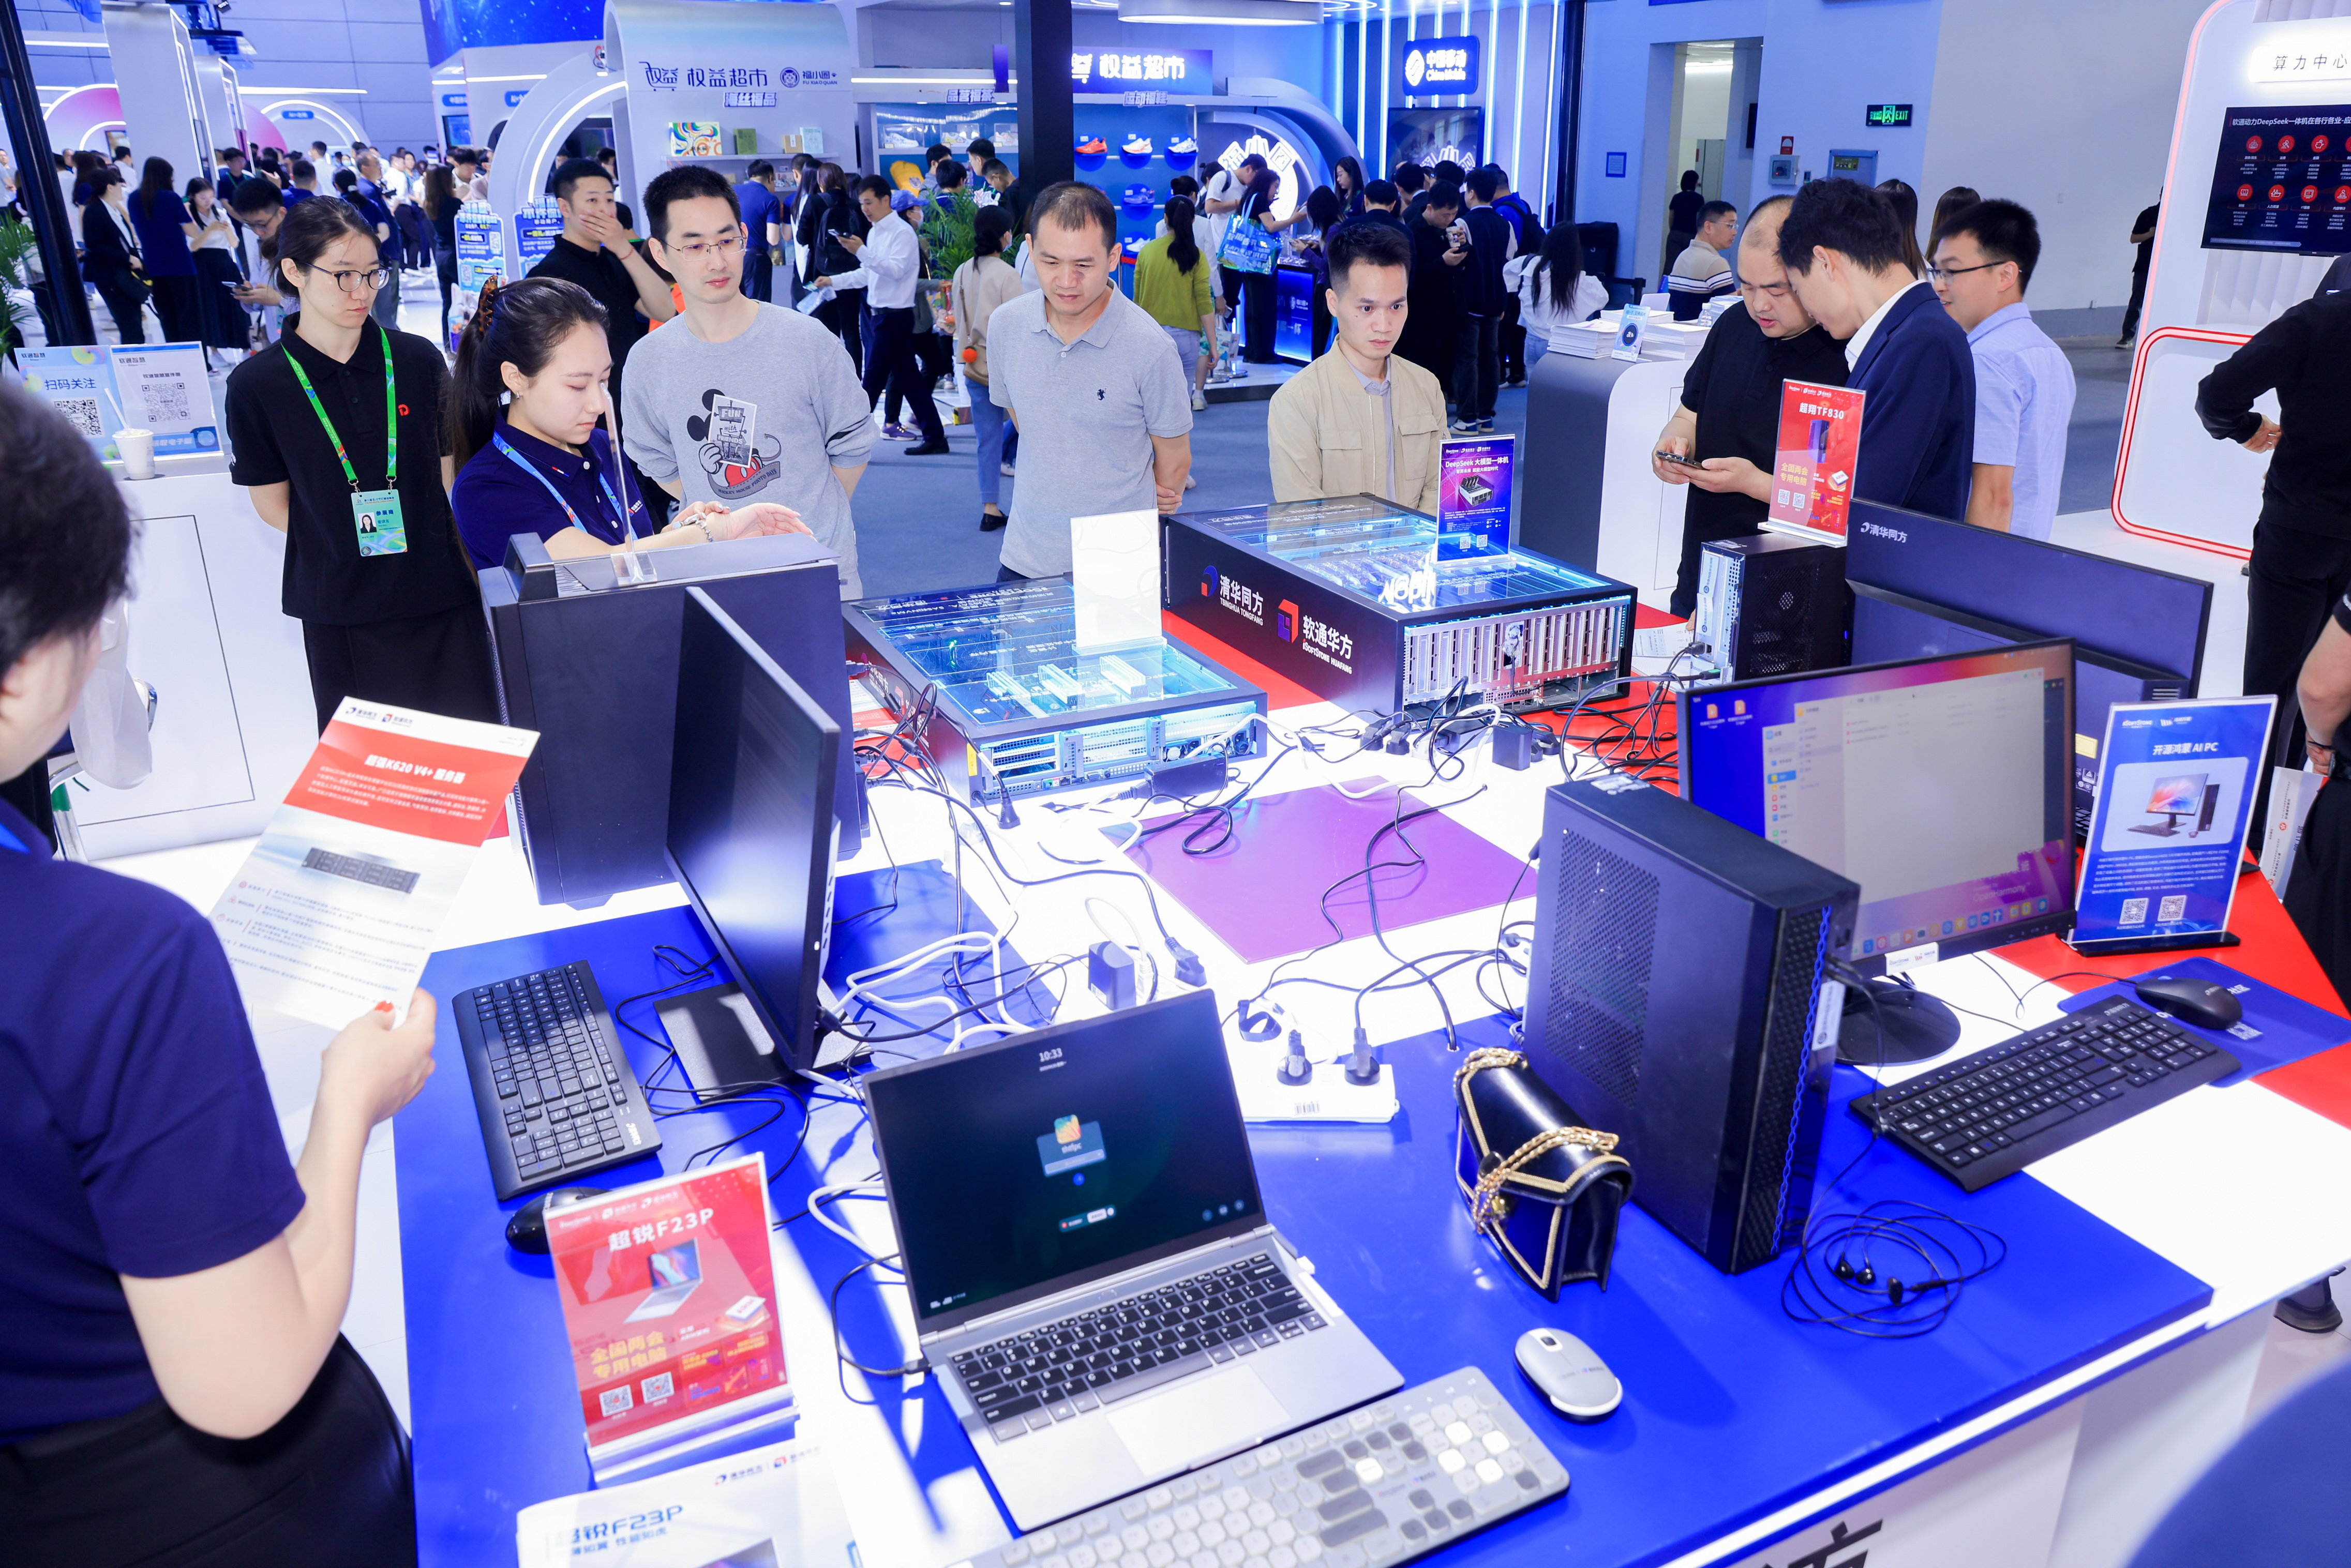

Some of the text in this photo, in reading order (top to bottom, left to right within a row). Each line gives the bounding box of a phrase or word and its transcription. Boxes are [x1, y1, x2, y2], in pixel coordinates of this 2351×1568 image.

[1100, 54, 1185, 80] 权益超市
[1426, 49, 1466, 68] 中国移动
[2273, 54, 2347, 71] 算力中心
[687, 68, 768, 87] 权益超市
[802, 70, 830, 80] 福小圈
[1426, 68, 1466, 81] China Mobile
[1895, 111, 1908, 120] EXIT
[44, 378, 97, 390] 扫码关注
[721, 409, 741, 418] FUN
[1799, 402, 1845, 420] 超翔TF830
[718, 435, 743, 445] FRIENDS
[1445, 456, 1509, 468] DeepSeek 大模型一体机
[1781, 462, 1808, 476] 全国两会
[736, 485, 752, 494] MOUSE
[751, 474, 767, 488] PHOTO
[766, 468, 778, 478] DAYS
[1780, 473, 1807, 486] 专用电脑
[1869, 523, 1908, 543] 清华同方
[1220, 574, 1263, 616] 清华同方
[878, 600, 928, 610] 清华同方
[960, 601, 1006, 610] 存储扩展区
[1220, 597, 1264, 626] TSINGHUA TONGFANG
[980, 615, 1027, 624] 散热风扇区
[1302, 615, 1353, 660] 软通华方
[1331, 657, 1352, 675] HUAFANG
[2152, 742, 2219, 755] 开源鸿蒙 AI PC
[364, 754, 466, 784] 超强K620 V4+ 服务器
[1973, 884, 2026, 902] OpenHarmony
[1039, 1048, 1064, 1062] 10:33
[608, 1208, 714, 1253] 超锐F23P
[590, 1330, 664, 1365] 全国两会
[593, 1346, 667, 1379] 专用电脑
